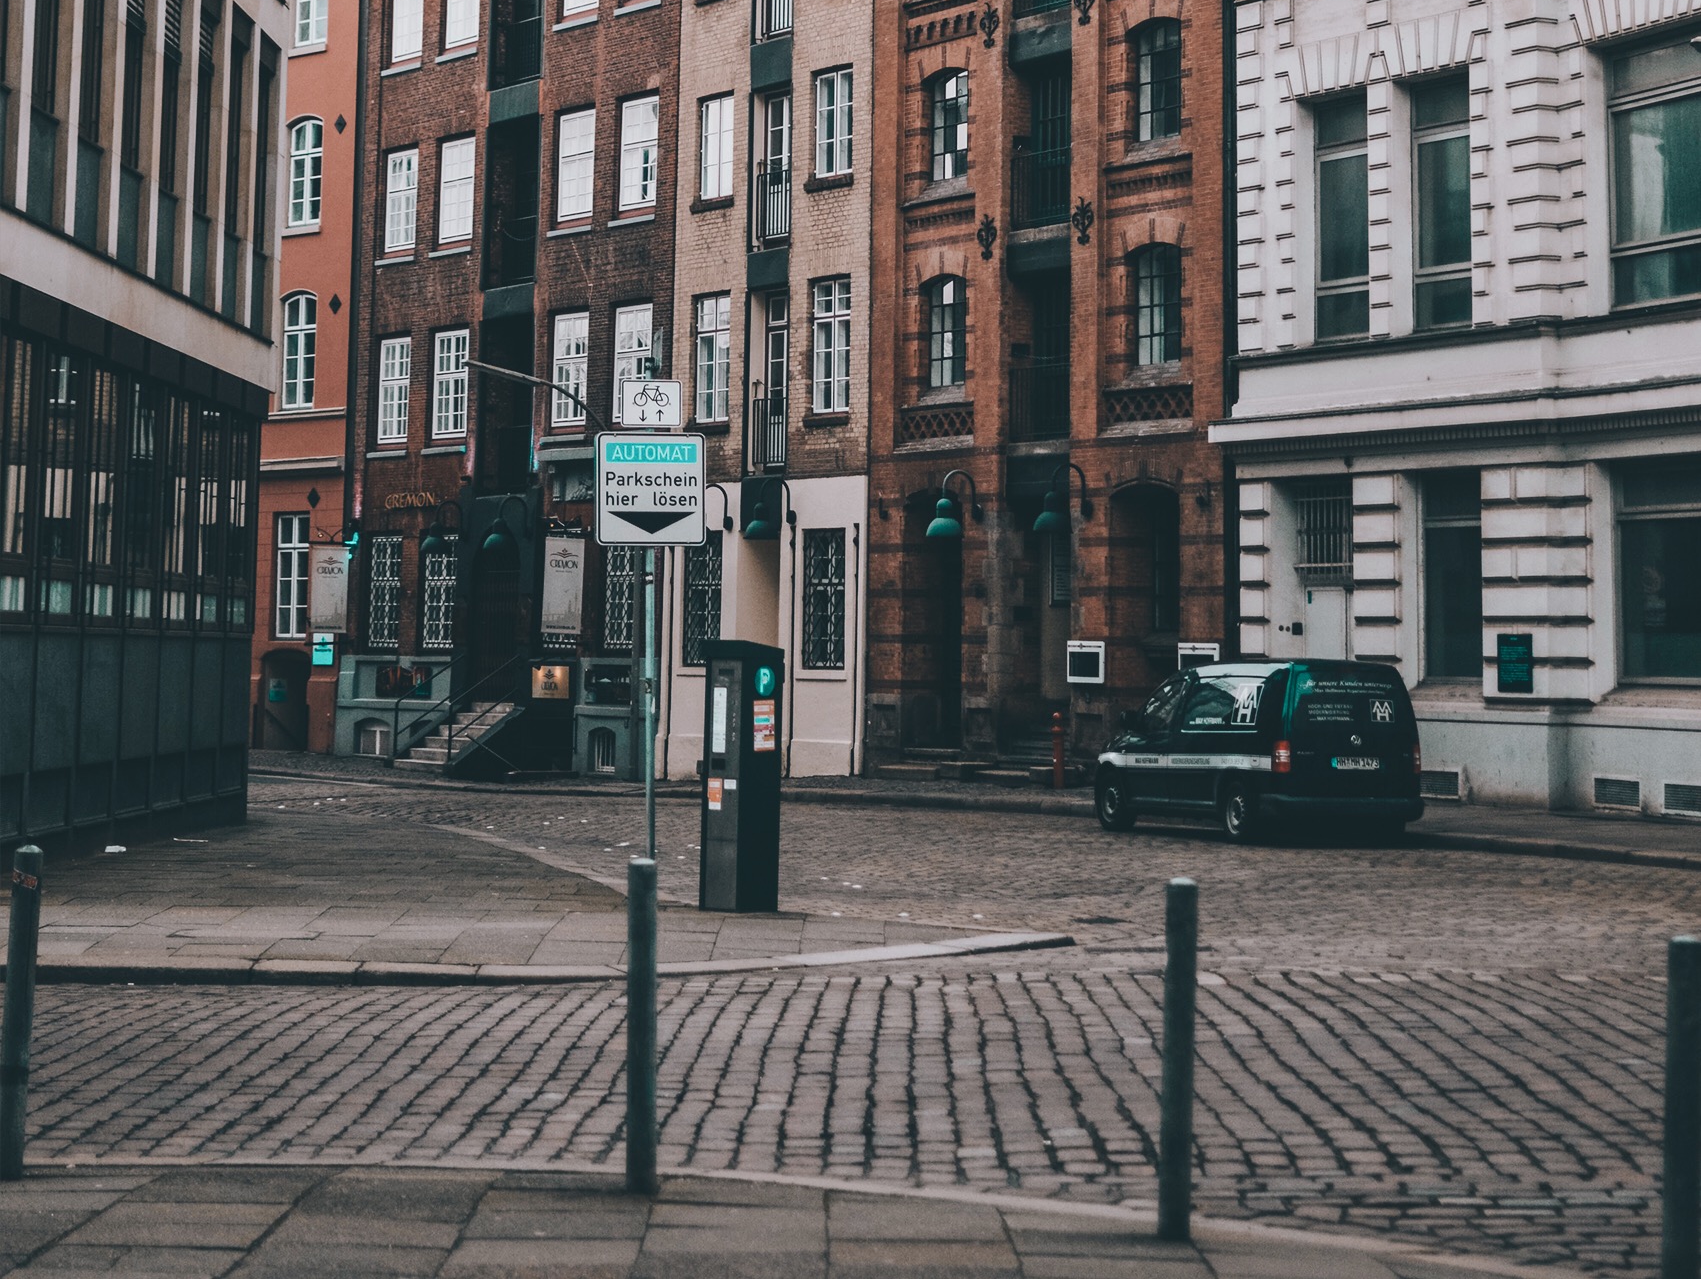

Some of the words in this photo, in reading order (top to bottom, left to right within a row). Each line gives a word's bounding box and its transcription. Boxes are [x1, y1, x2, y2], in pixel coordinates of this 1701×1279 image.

[611, 445, 692, 461] AUTOMAT
[605, 471, 698, 487] Parkschein
[384, 491, 436, 510] CREMON
[605, 491, 639, 507] hier
[653, 491, 698, 507] lösen
[316, 566, 344, 575] CREMON
[550, 559, 579, 570] CREMON
